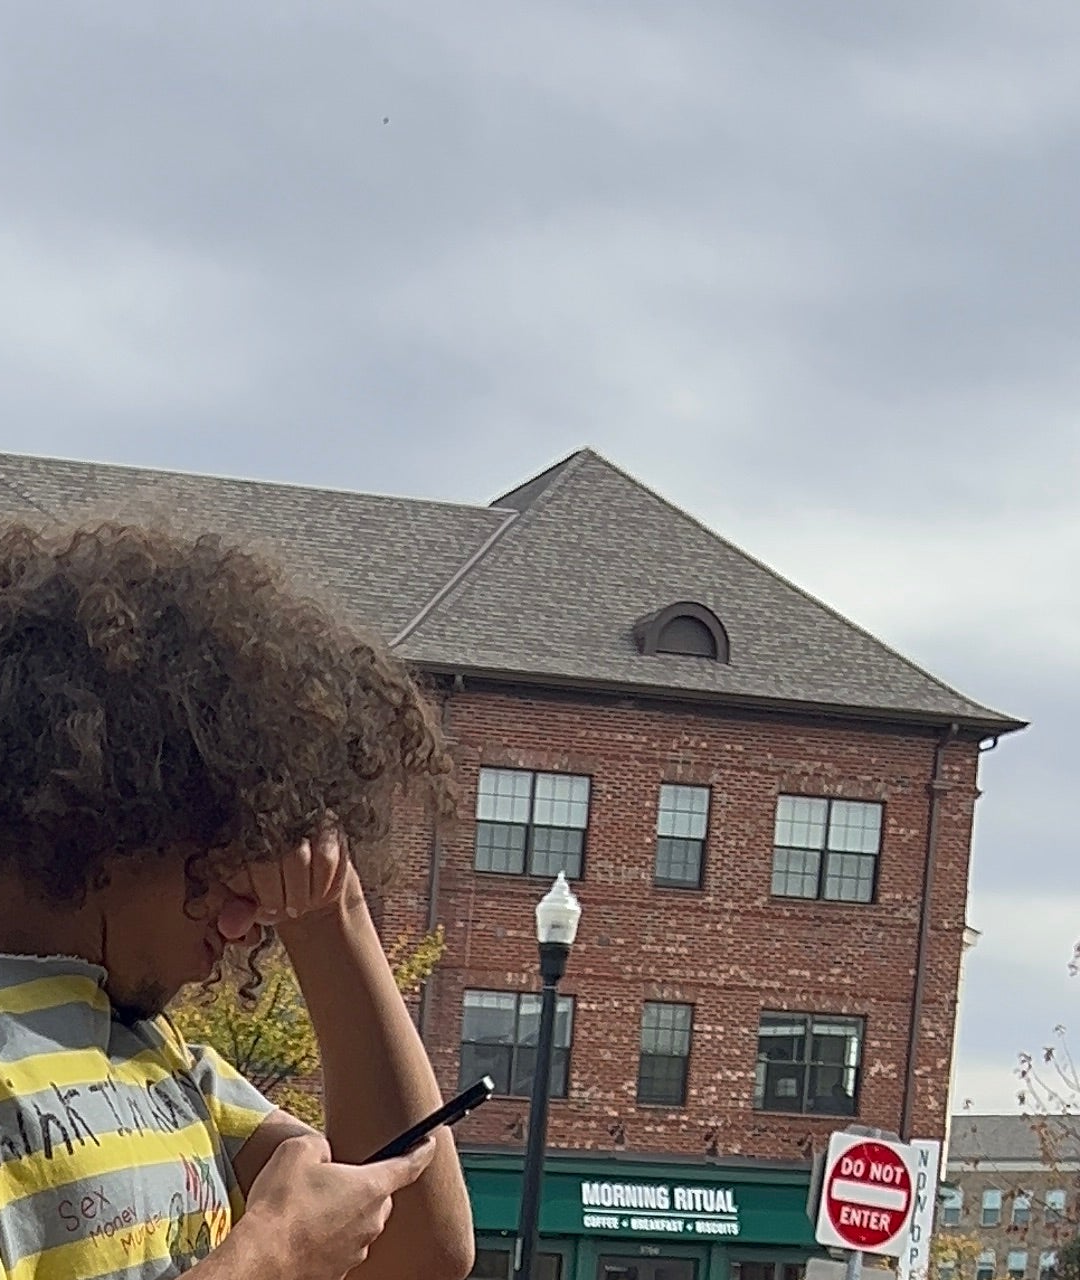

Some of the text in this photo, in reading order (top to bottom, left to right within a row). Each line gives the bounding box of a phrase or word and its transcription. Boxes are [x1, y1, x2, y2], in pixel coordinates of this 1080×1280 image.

[840, 1157, 905, 1185] DO NOT
[58, 1185, 111, 1232] Sex
[581, 1182, 738, 1213] MORNING RITUAL
[89, 1203, 138, 1248] Money
[583, 1215, 740, 1236] COFFEE BREAKFAST BISCUITS
[840, 1206, 892, 1233] ENTER
